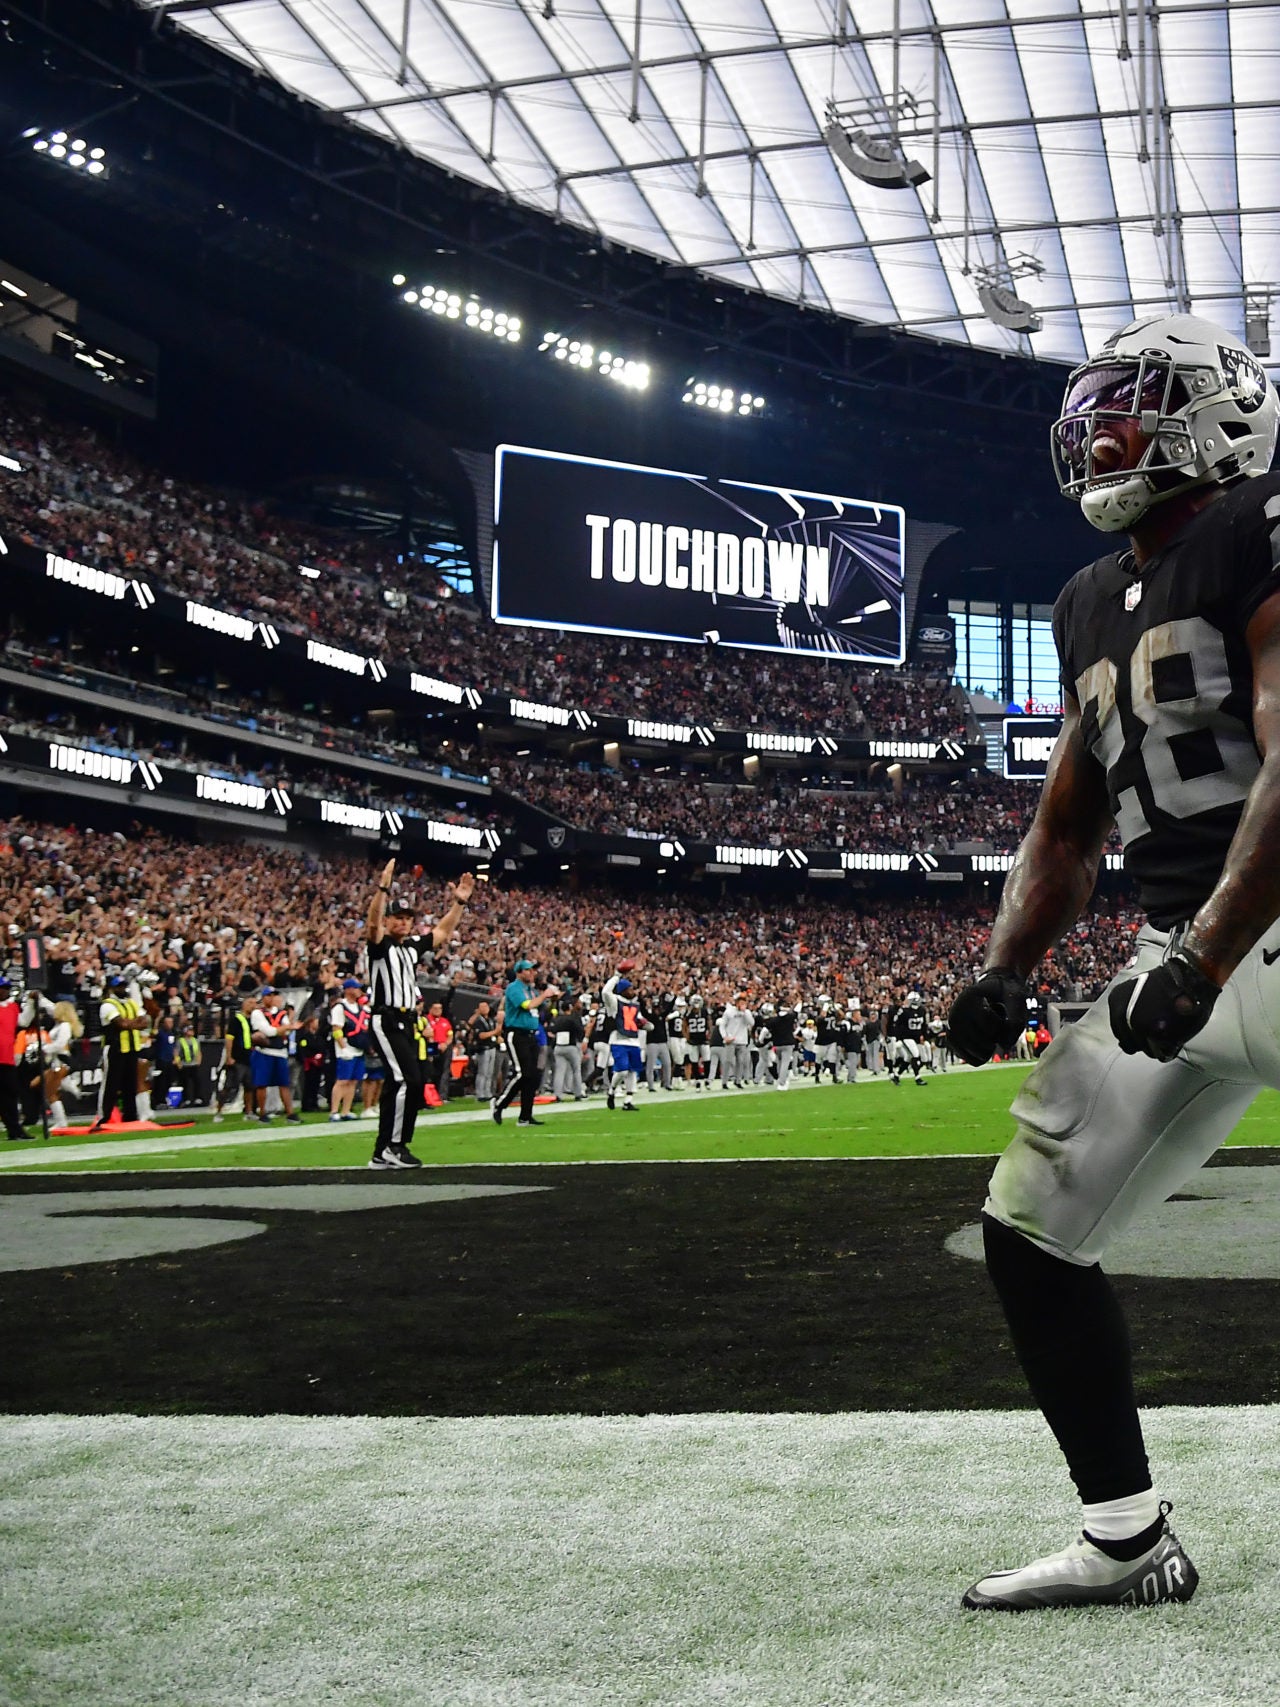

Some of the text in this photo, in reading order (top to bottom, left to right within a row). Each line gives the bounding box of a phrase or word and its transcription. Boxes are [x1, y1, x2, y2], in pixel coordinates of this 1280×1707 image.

[1223, 347, 1264, 374] RAIDERS
[585, 514, 829, 607] TOUCHDOWN
[1075, 616, 1263, 856] 28
[688, 1018, 706, 1033] 22
[908, 1018, 924, 1030] 67
